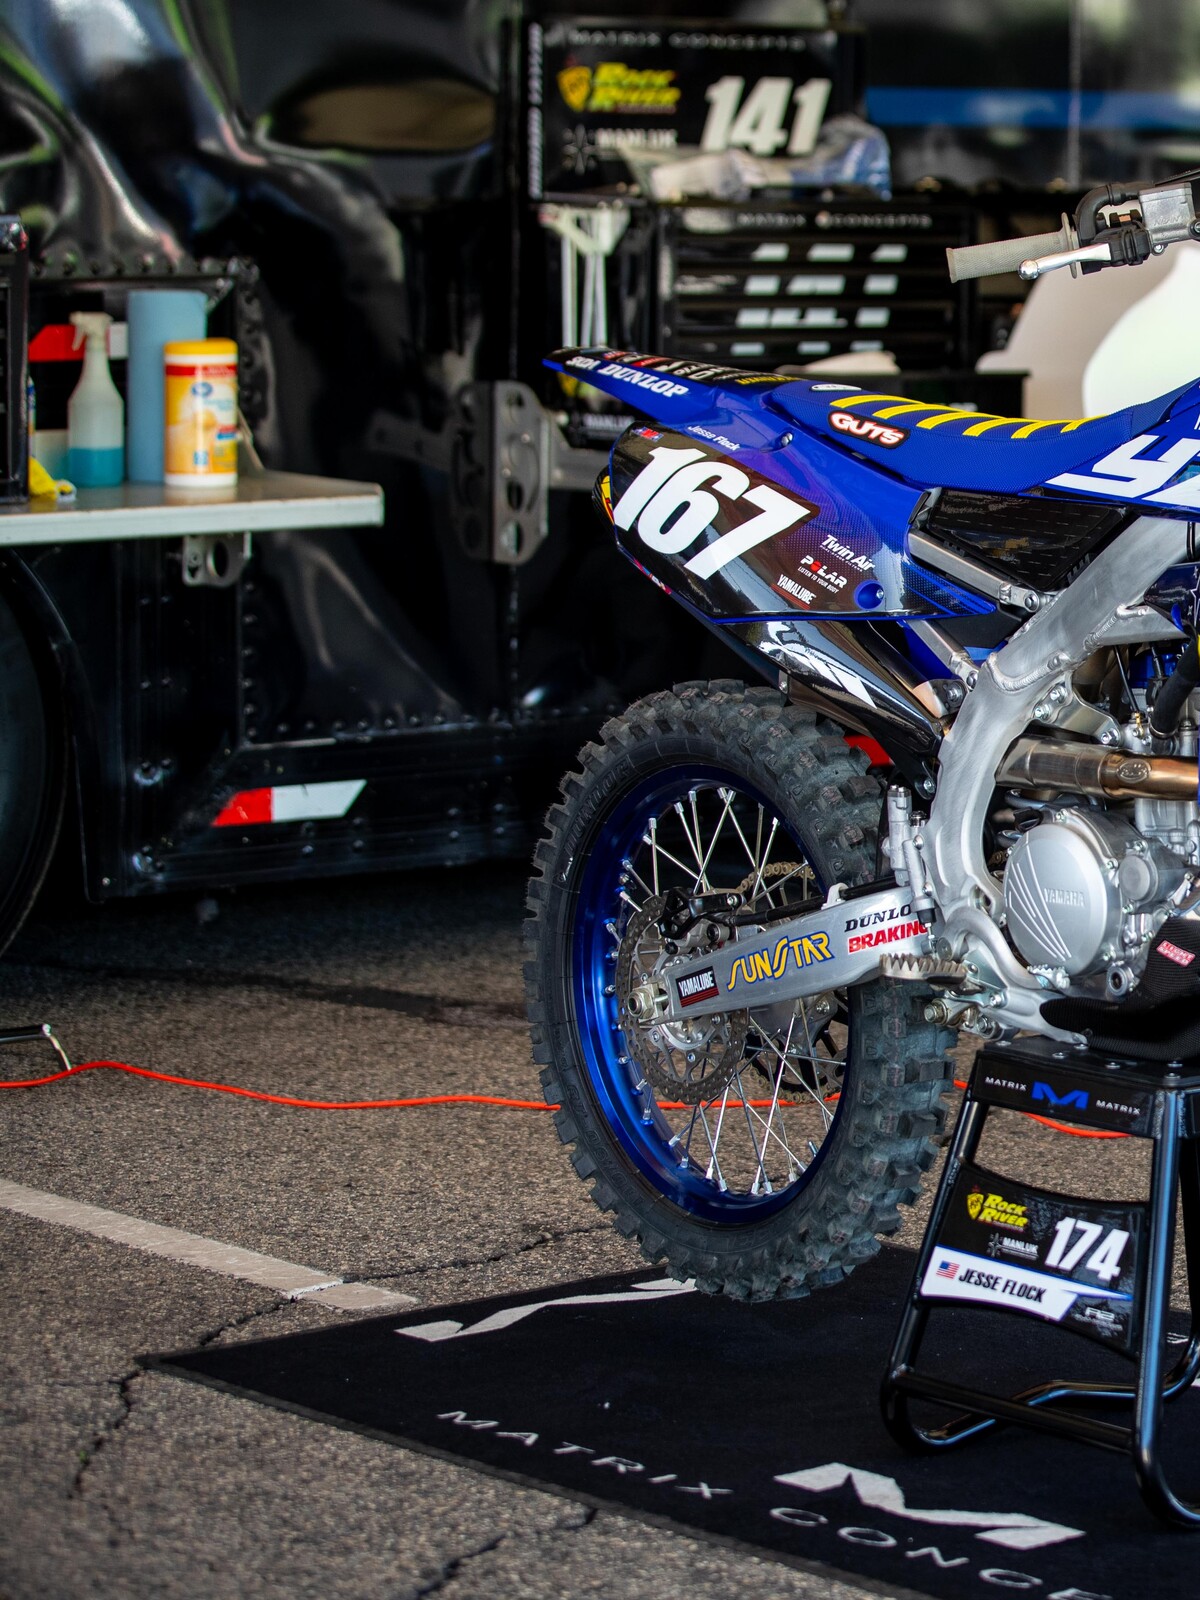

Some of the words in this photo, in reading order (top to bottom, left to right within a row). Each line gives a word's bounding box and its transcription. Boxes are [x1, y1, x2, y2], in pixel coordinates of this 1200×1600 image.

[702, 75, 832, 156] 141
[597, 363, 690, 398] DUNLOP
[688, 425, 715, 442] Jesse
[713, 435, 742, 451] Flock
[830, 411, 905, 446] GUTS
[612, 446, 811, 580] 167
[821, 534, 855, 561] Twin
[850, 555, 876, 571] Air
[776, 574, 817, 605] YAMALUBE
[797, 566, 811, 578] LISTEN
[816, 577, 829, 588] YOUR
[826, 584, 840, 594] BODY
[1043, 887, 1086, 907] YAMAHA
[845, 903, 913, 932] DUNLO
[727, 930, 834, 991] SUNSTAR
[678, 971, 715, 998] YAMALUBE
[985, 1076, 1027, 1091] MATRIX
[1096, 1099, 1141, 1115] MATRIX
[978, 1207, 1030, 1228] RIVER
[983, 1192, 1028, 1216] ROCK
[1002, 1237, 1039, 1254] MANLUK
[1044, 1216, 1130, 1281] 174
[958, 1268, 1003, 1293] JESSE
[1001, 1280, 1047, 1303] FLOCK
[436, 1409, 733, 1498] MATRIX
